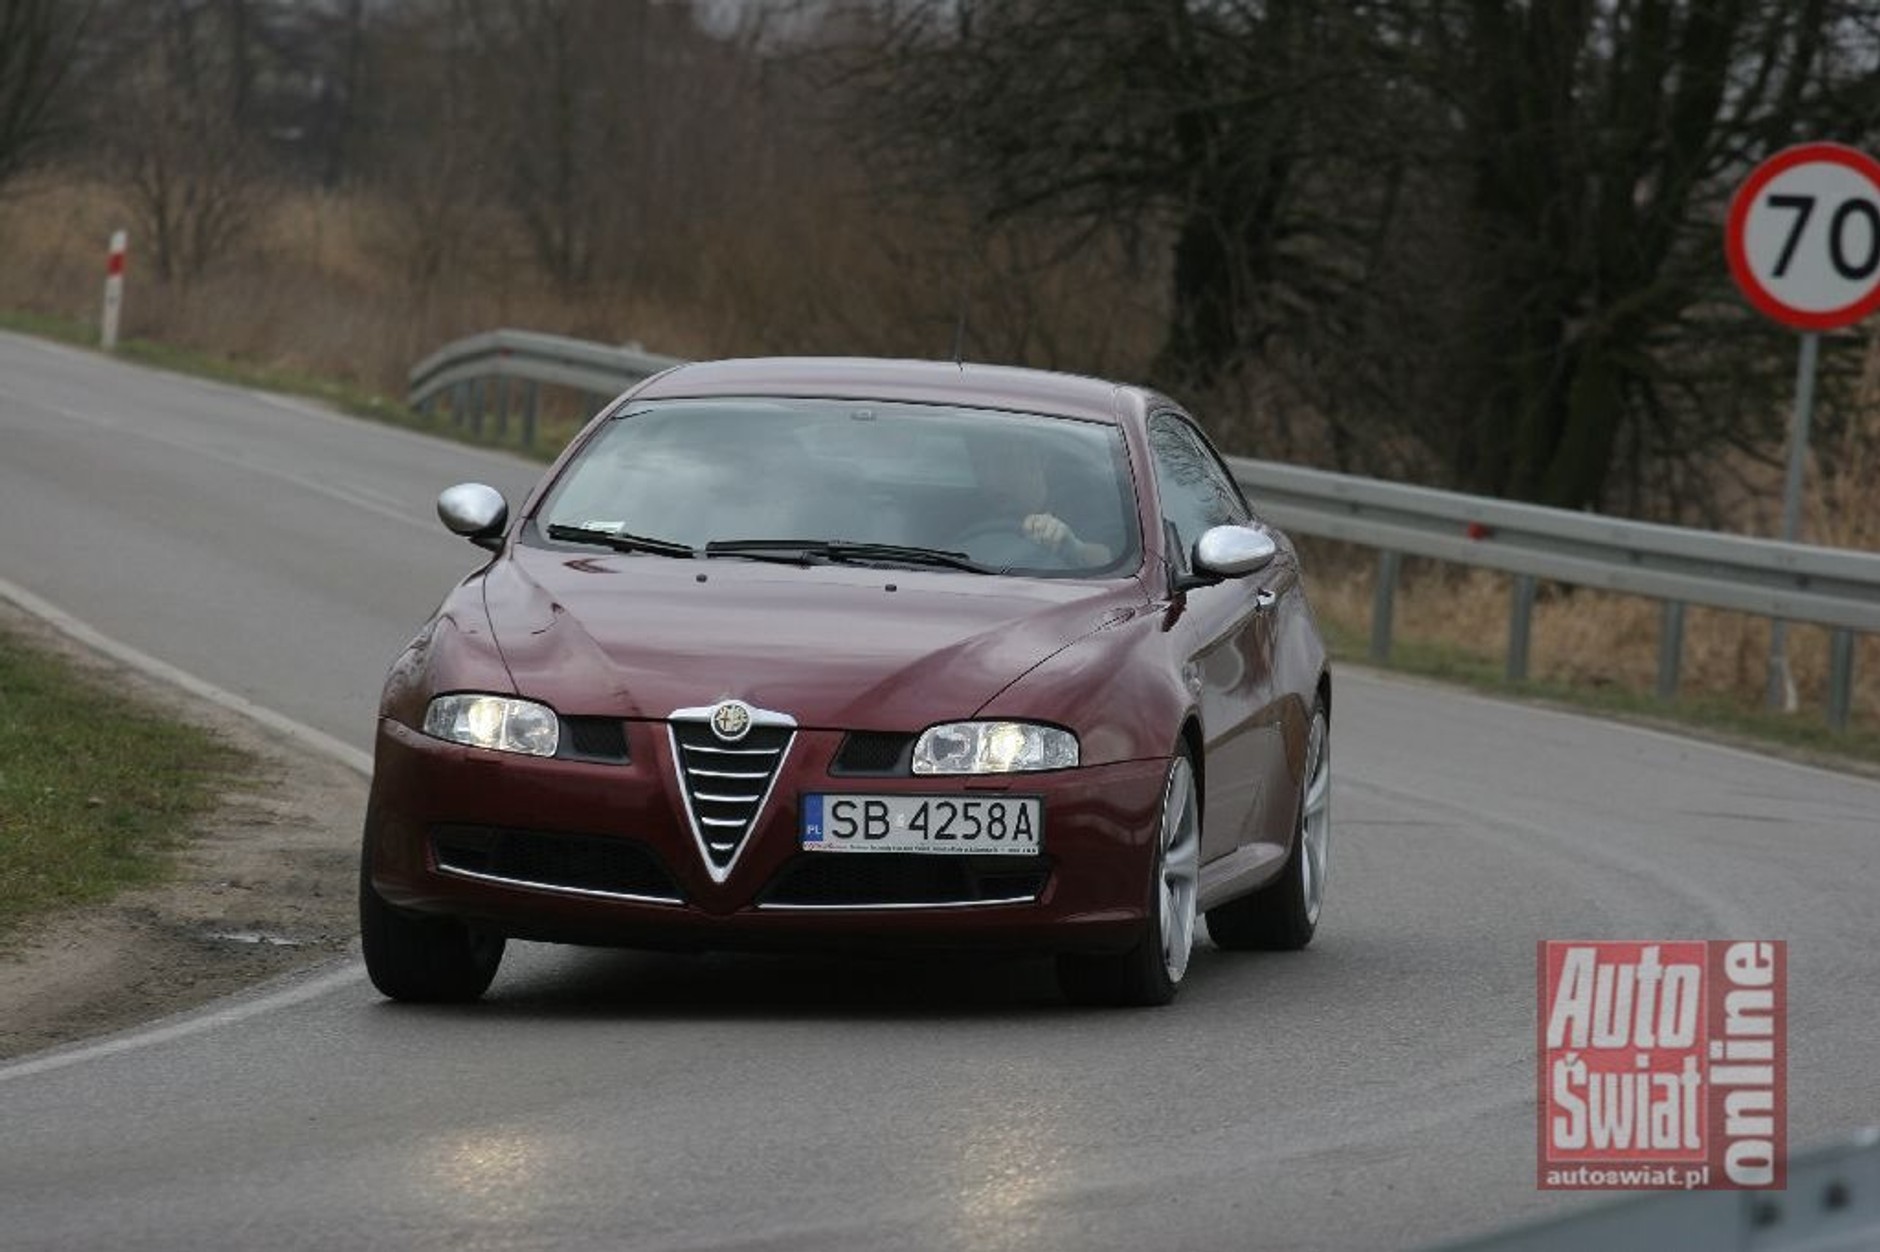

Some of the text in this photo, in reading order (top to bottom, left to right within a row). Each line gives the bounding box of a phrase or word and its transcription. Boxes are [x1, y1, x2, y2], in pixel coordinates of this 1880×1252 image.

[1766, 195, 1880, 280] 70
[807, 825, 822, 835] PL
[831, 800, 1034, 841] SB 4258A
